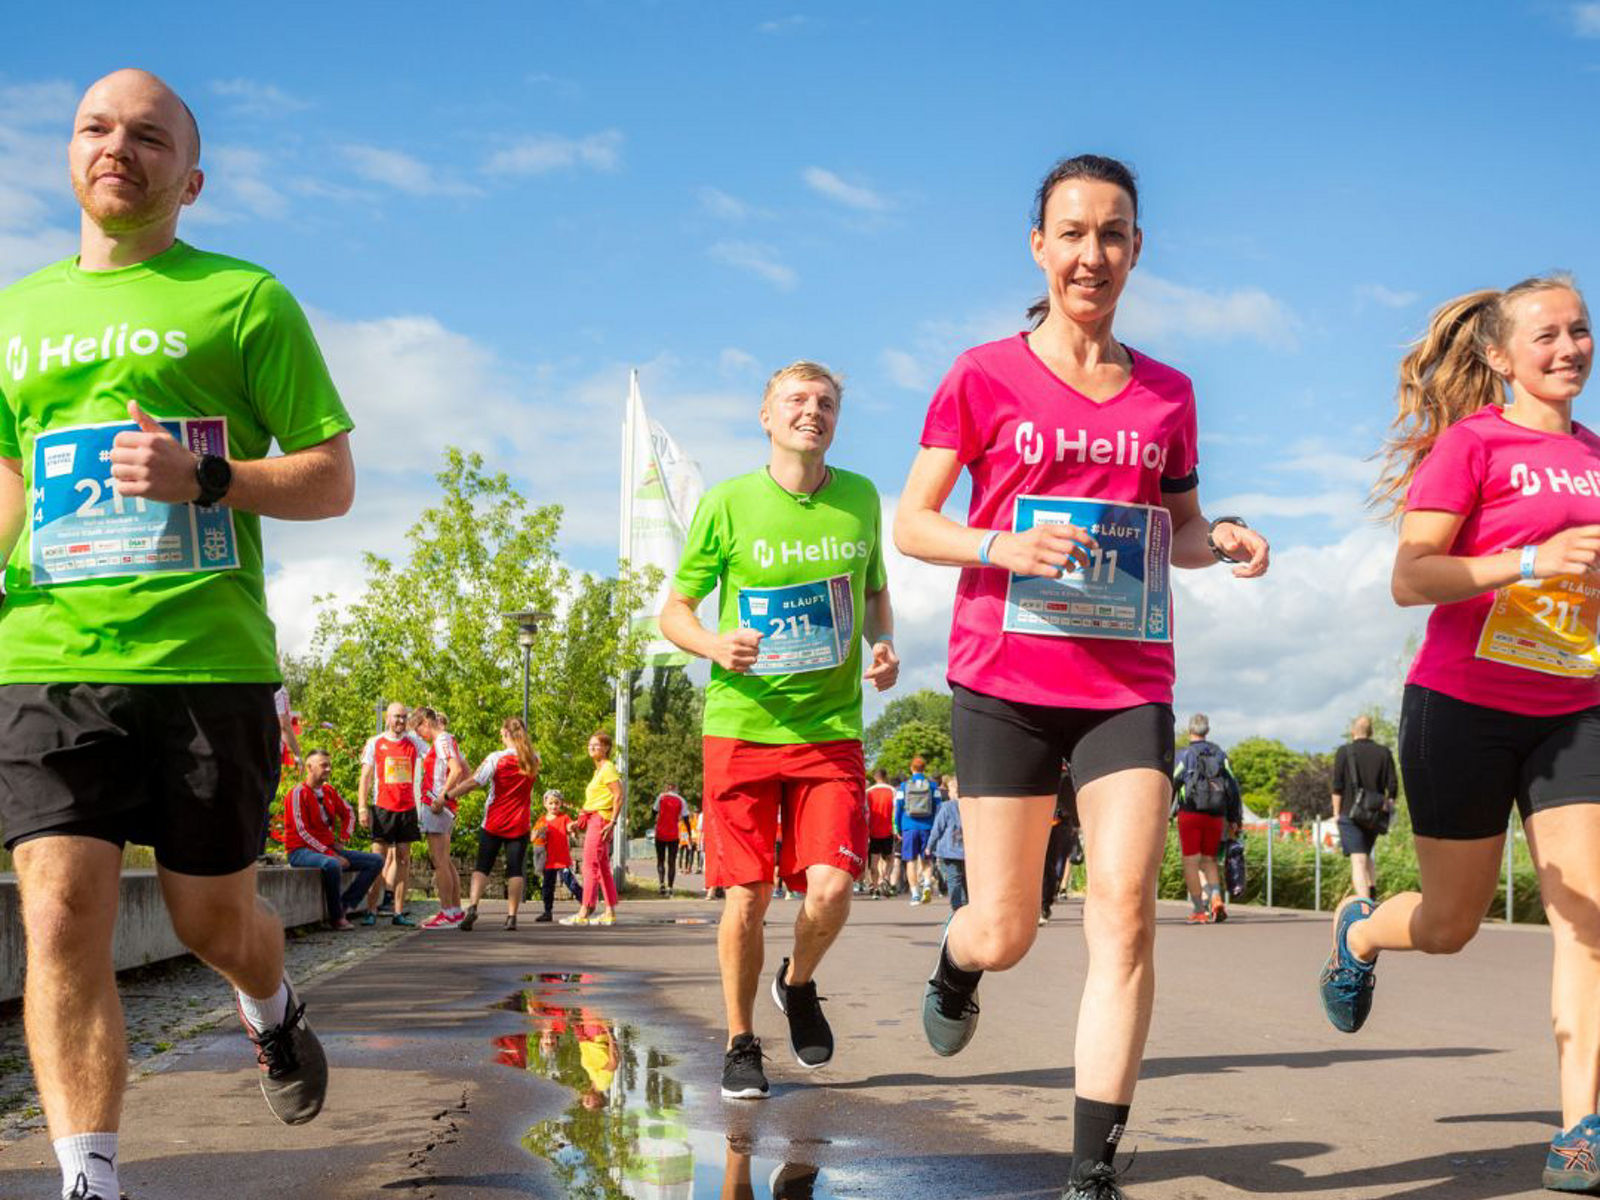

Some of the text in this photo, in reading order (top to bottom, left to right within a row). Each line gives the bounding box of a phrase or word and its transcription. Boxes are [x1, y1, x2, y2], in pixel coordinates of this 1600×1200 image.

[38, 323, 188, 372] Helios
[1091, 521, 1141, 539] #LÄUFT
[781, 536, 868, 565] Helios
[783, 594, 826, 609] #LÄUFT
[1536, 596, 1581, 633] 211
[769, 613, 812, 641] 211
